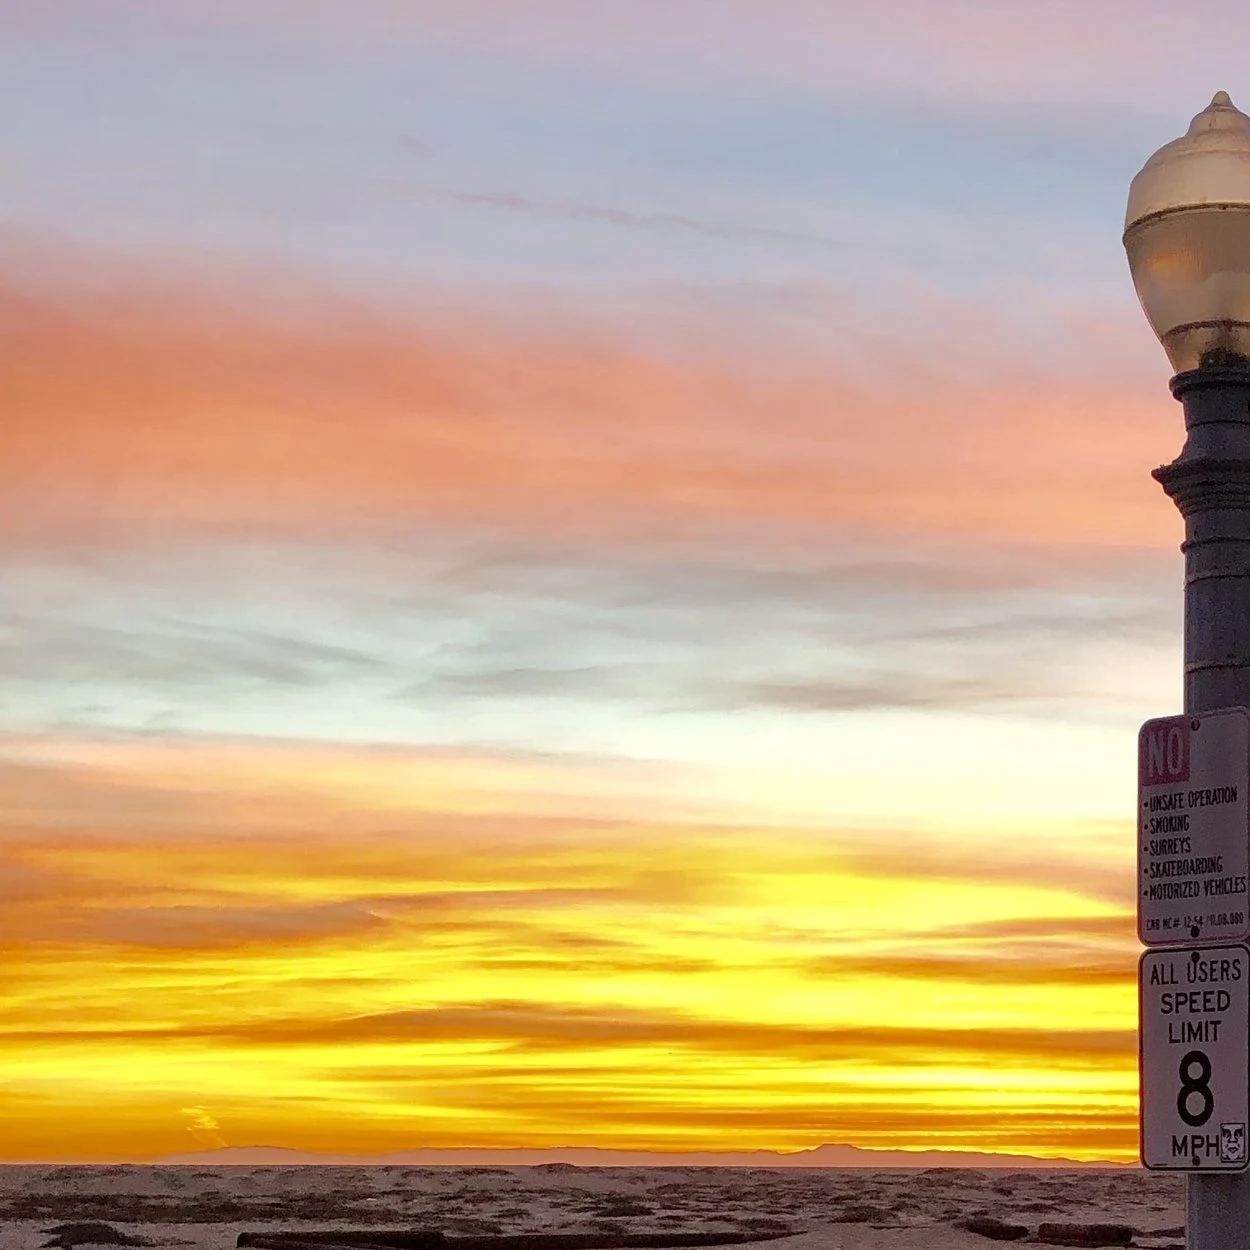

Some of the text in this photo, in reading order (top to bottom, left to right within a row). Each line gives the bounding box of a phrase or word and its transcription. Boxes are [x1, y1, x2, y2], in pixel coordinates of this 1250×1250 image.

[1149, 727, 1184, 777] NO
[1150, 786, 1238, 812] UNSAFE OPERATION
[1150, 815, 1190, 834] SMOKING
[1150, 837, 1191, 856] SURREYS
[1150, 856, 1223, 879] SKATEBOARDING
[1150, 876, 1247, 900] MOTORIZED VEHICLES
[1151, 959, 1241, 985] ALL USERS
[1160, 990, 1231, 1015] SPEED
[1168, 1020, 1222, 1044] LIMIT
[1177, 1050, 1214, 1127] 8
[1172, 1135, 1220, 1157] MPH
